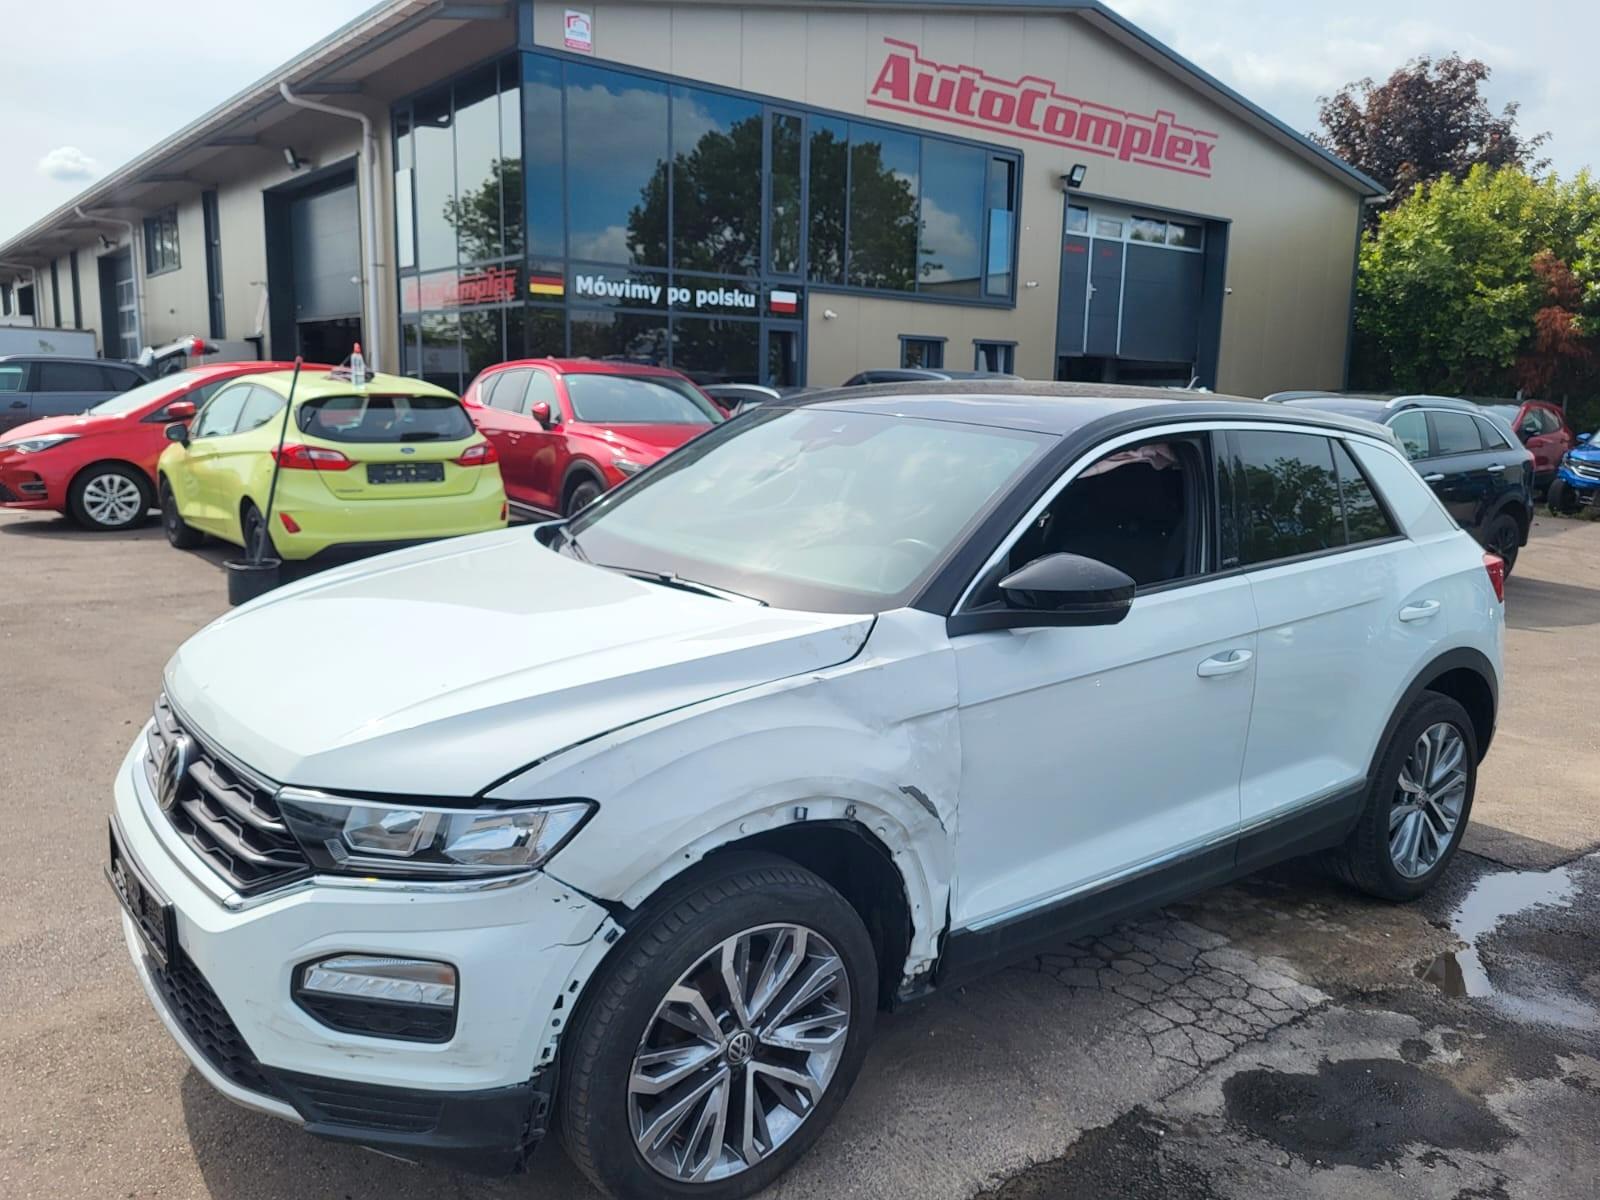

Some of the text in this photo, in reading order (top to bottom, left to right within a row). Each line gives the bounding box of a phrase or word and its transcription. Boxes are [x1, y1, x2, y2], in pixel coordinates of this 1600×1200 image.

[872, 53, 1216, 171] AutoComplex
[406, 268, 517, 308] omplex
[576, 275, 756, 308] Mówimy po polsku
